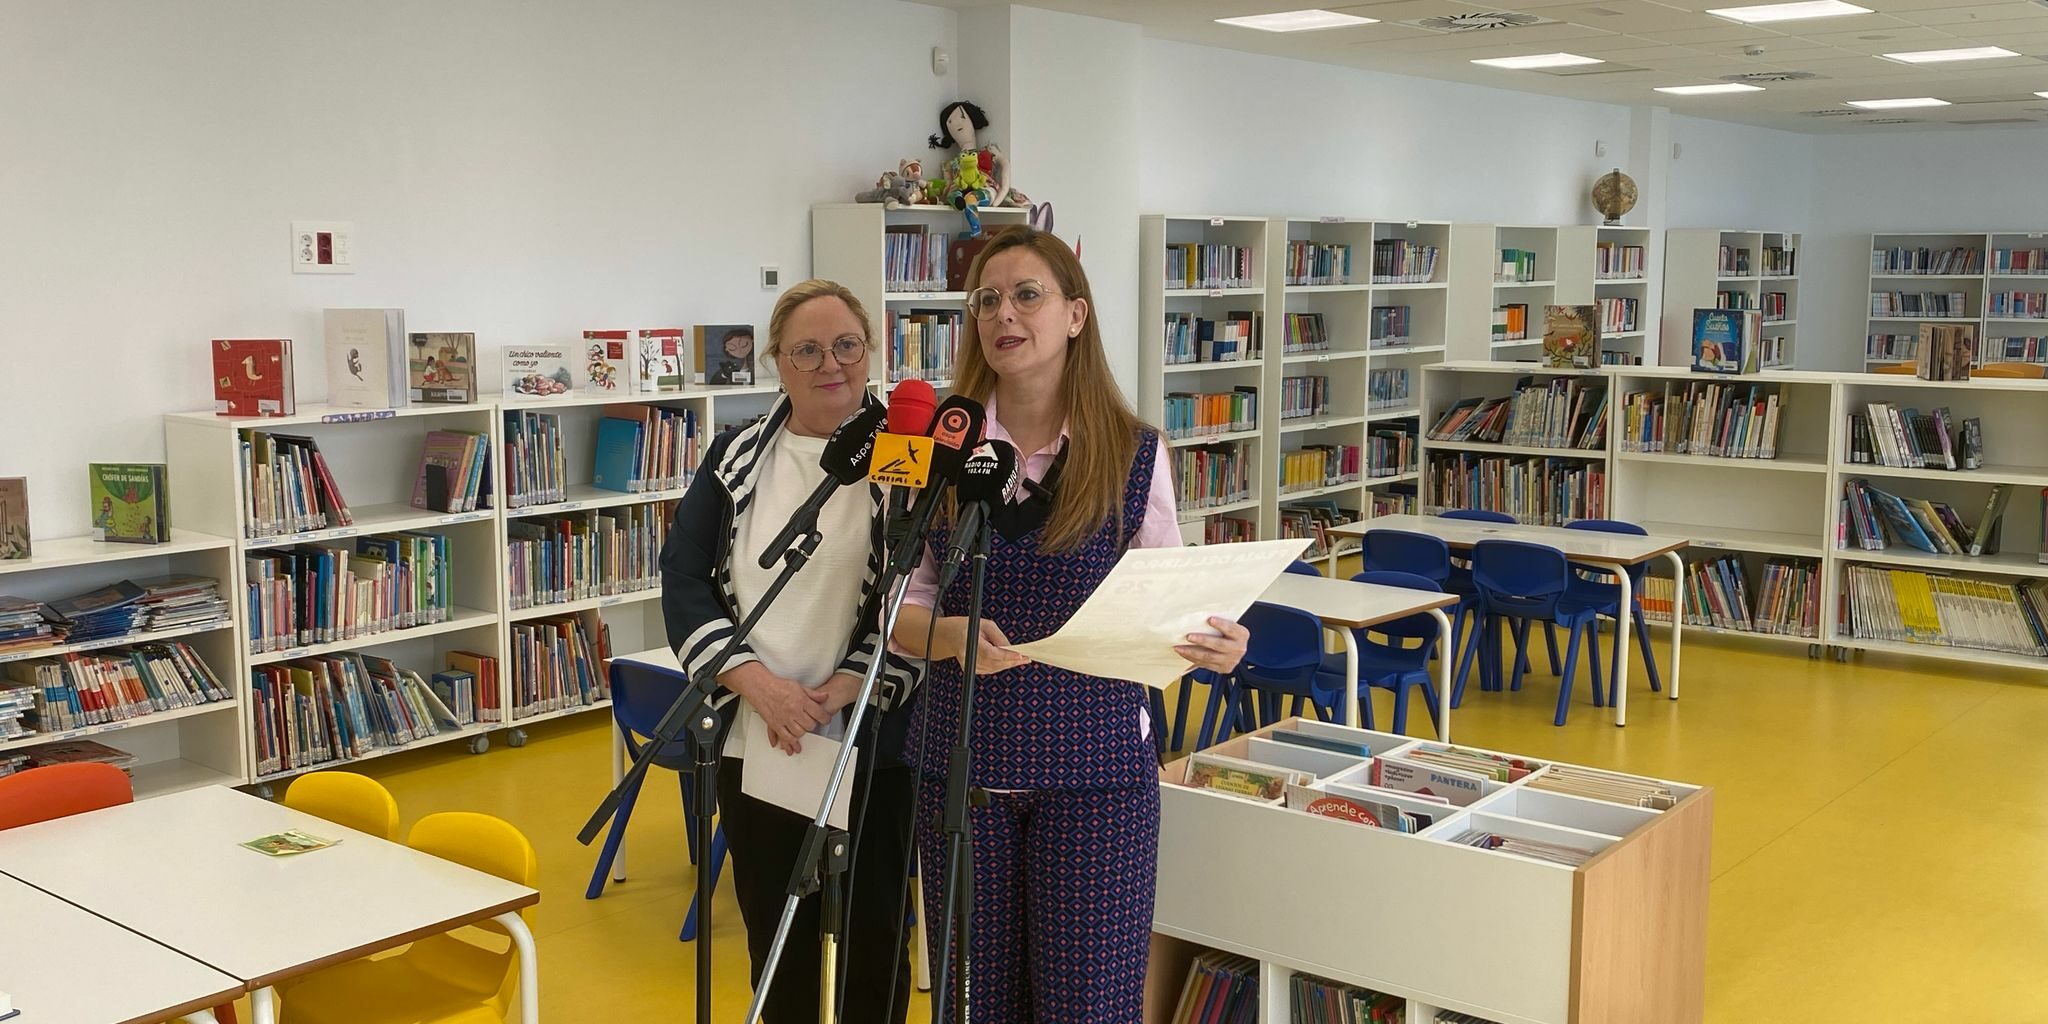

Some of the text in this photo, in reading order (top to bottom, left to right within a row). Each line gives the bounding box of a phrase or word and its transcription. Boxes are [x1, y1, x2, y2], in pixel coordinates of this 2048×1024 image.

[520, 350, 534, 358] chico
[535, 350, 562, 358] valiente
[529, 360, 538, 368] yo
[850, 442, 872, 466] Aspe
[964, 461, 999, 469] RADIO ASPE
[102, 473, 149, 483] CHÓFER DE SANDÍAS
[1430, 773, 1478, 791] PANTERA
[1310, 802, 1376, 828] Aprende con
